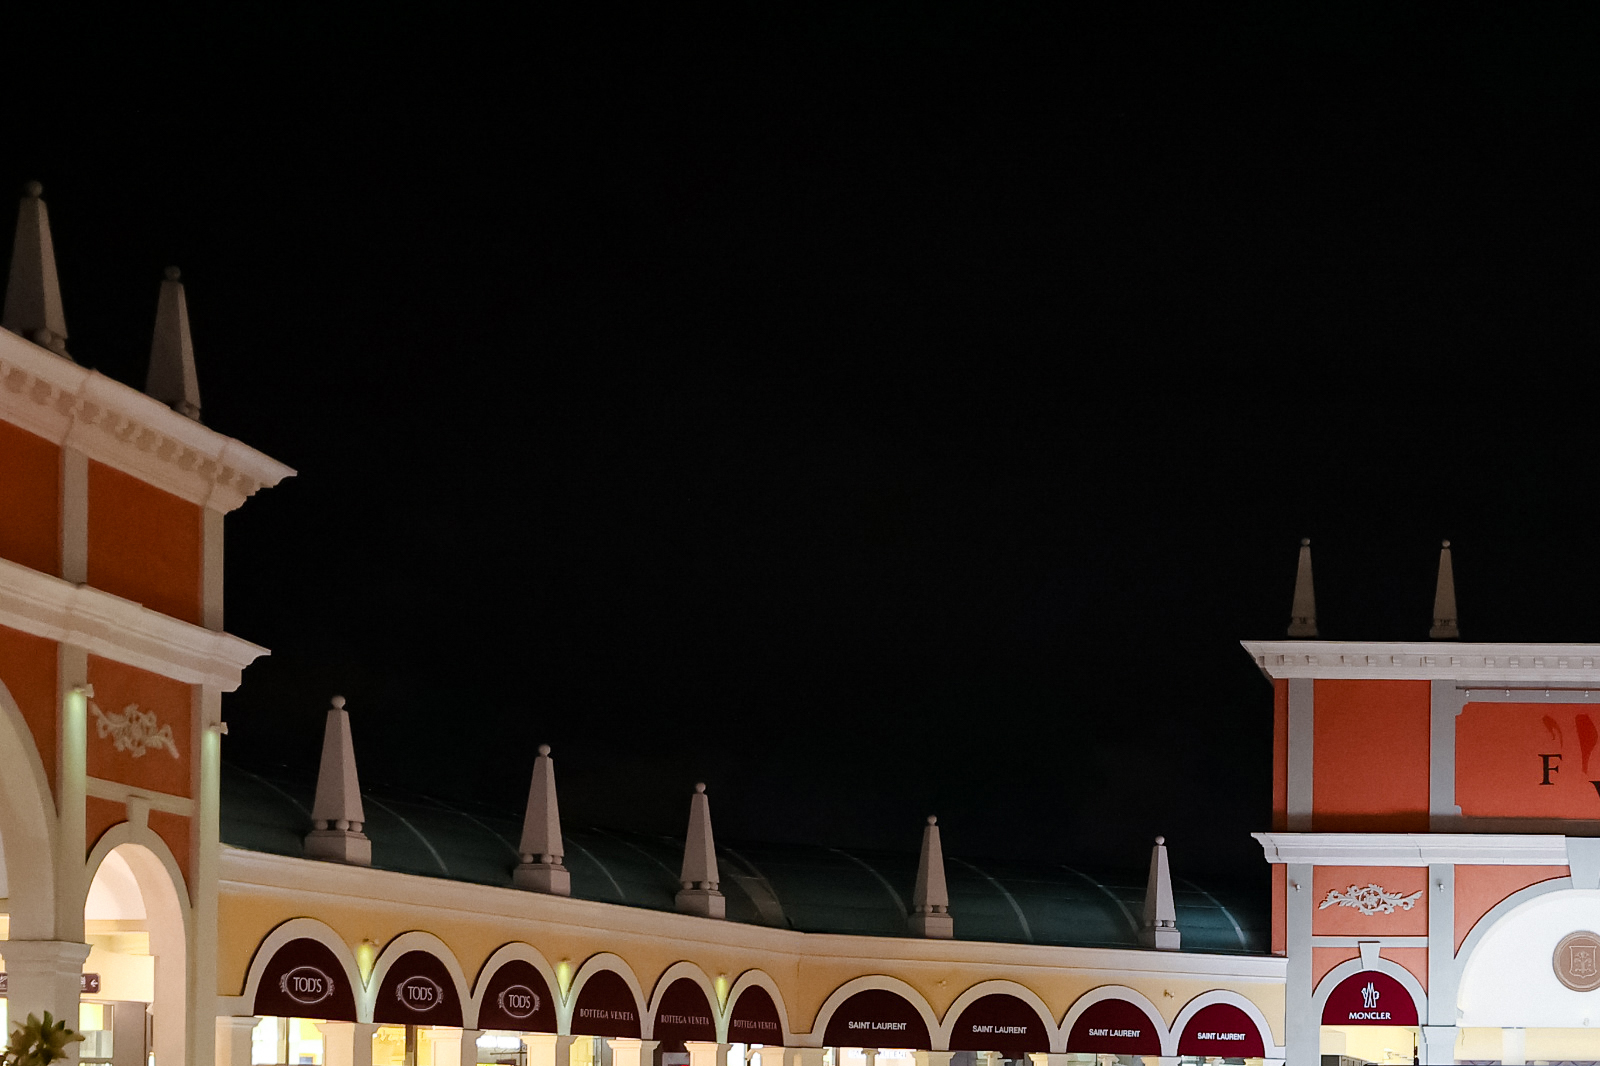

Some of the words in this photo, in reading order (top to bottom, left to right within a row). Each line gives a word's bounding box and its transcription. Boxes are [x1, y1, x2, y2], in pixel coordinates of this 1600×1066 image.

[1538, 754, 1562, 786] F
[293, 977, 322, 993] TOD'S
[407, 986, 433, 1001] TOD'S
[508, 995, 530, 1009] TOD'S
[580, 1008, 609, 1019] BOTTEGA
[610, 1010, 634, 1021] VENETA
[661, 1014, 687, 1024] BOTTEGA
[687, 1016, 710, 1025] VENETA
[1348, 1011, 1391, 1020] MONCLER
[733, 1019, 757, 1029] BOTTEGA
[757, 1021, 777, 1030] VENETA
[848, 1021, 870, 1030] SAINT
[871, 1022, 907, 1031] LAURENT
[972, 1025, 993, 1033] SAINT
[994, 1026, 1027, 1034] LAURENT
[1088, 1028, 1108, 1036] SAINT
[1109, 1029, 1140, 1038] LAURENT
[1197, 1032, 1216, 1040] SAINT
[1216, 1033, 1246, 1041] LAURENT
